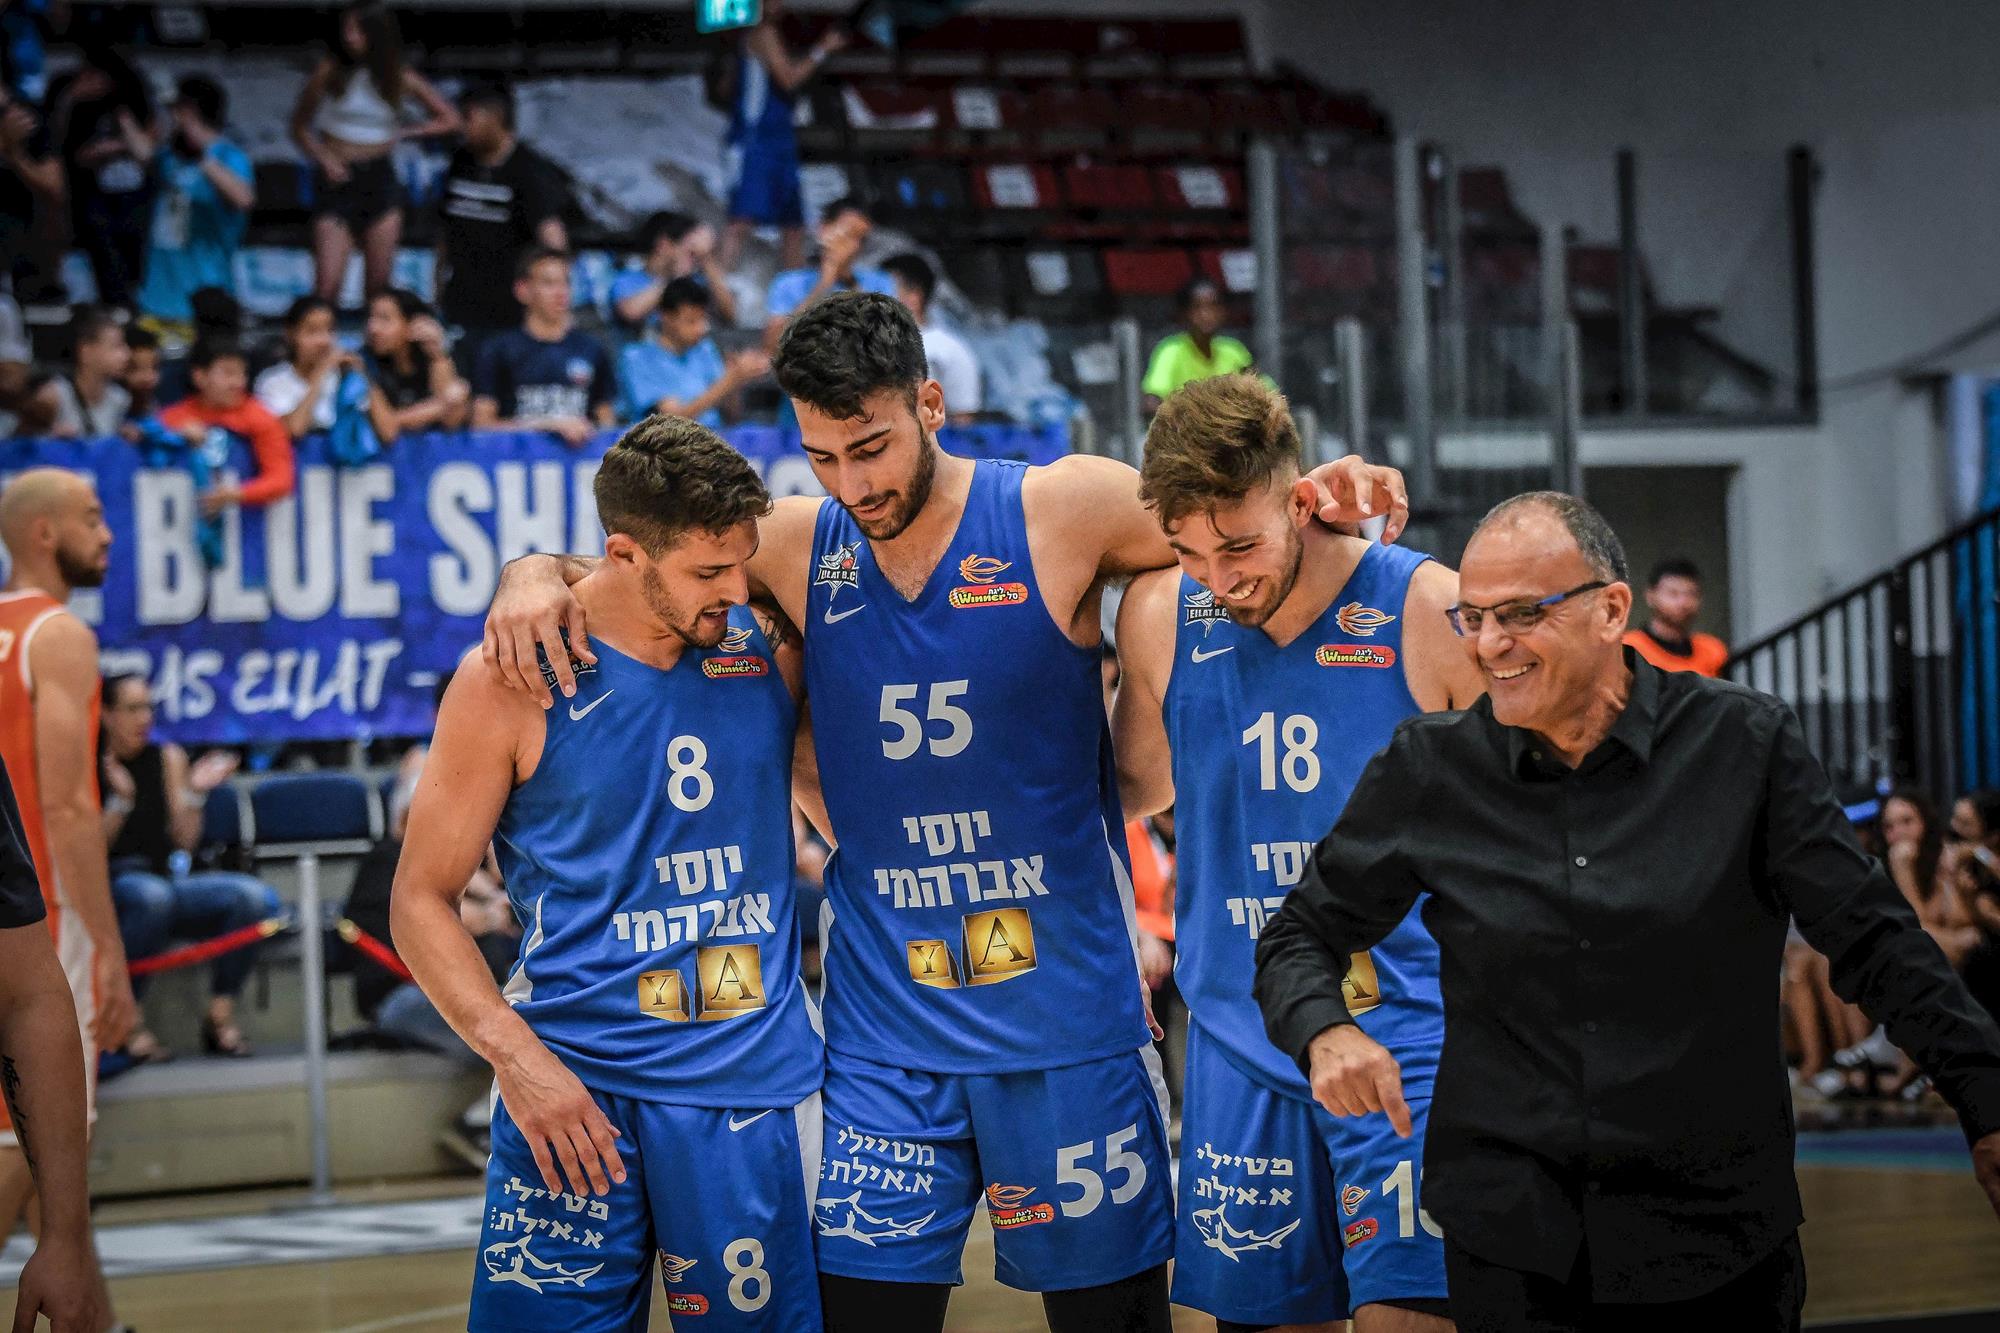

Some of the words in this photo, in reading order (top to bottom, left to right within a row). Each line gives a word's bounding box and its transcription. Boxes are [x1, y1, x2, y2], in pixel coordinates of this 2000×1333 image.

[134, 464, 401, 624] BLUE
[958, 592, 1006, 604] Winner
[1006, 591, 1019, 600] סל
[1190, 608, 1213, 619] EILAT
[231, 638, 403, 721] EILAT
[709, 663, 751, 675] Winner
[1324, 650, 1372, 663] Winner
[879, 679, 973, 760] 55
[667, 734, 714, 812] 8
[1242, 711, 1321, 793] 18
[902, 810, 992, 857] יוסי
[654, 845, 744, 896] יוסי
[873, 854, 1050, 909] אברהמי
[911, 944, 943, 974] Y
[978, 916, 1030, 967] A
[642, 974, 675, 1006] Y
[710, 951, 760, 1002] A
[837, 1125, 936, 1167] מטיילי
[1056, 1122, 1147, 1217] 55
[1196, 1142, 1294, 1176] מטיילי
[722, 1237, 772, 1312] 8
